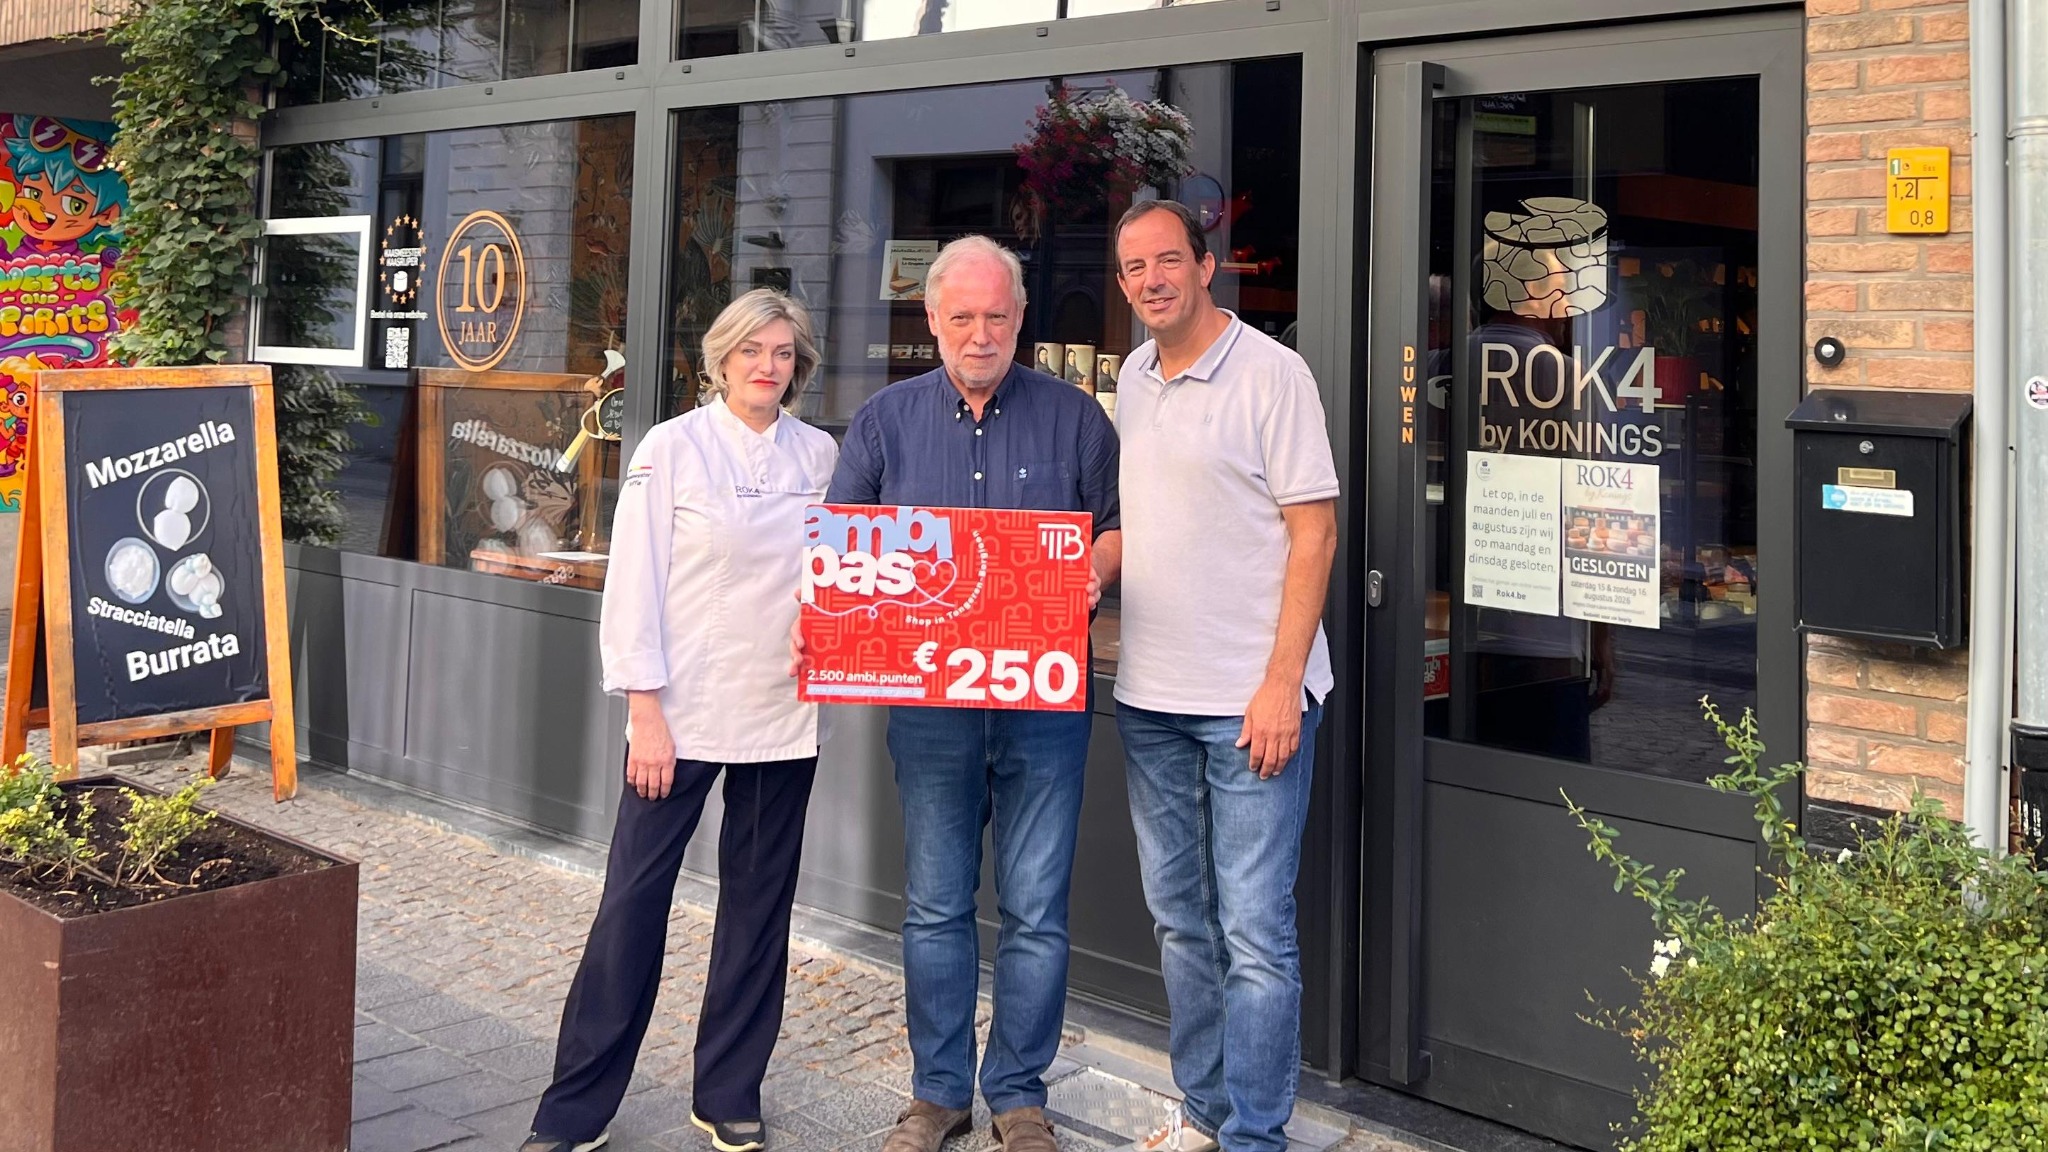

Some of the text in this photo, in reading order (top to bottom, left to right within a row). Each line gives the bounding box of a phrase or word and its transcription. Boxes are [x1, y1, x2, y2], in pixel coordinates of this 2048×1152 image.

[1893, 182, 1914, 200] 1,2
[1910, 210, 1933, 228] 0,8
[455, 244, 506, 313] 10
[458, 321, 497, 345] JAAR
[1481, 342, 1663, 414] ROK4
[1400, 346, 1417, 443] DUWEN
[1480, 416, 1662, 457] by KONINGS
[85, 420, 236, 489] Mozzarella
[1576, 465, 1634, 490] ROK4
[1482, 488, 1544, 503] Let op, in de
[1473, 505, 1553, 520] maanden juli en
[804, 506, 953, 559] ambi
[1472, 521, 1554, 541] augustus zijn wij
[1474, 539, 1551, 556] op maandag en
[801, 544, 917, 603] pas
[1468, 553, 1556, 574] dinsdag gesloten.
[1572, 556, 1647, 579] GESLOTEN
[1496, 589, 1527, 600] Rok4.be
[1571, 581, 1596, 591] zaterdag
[1598, 583, 1605, 591] 15
[1613, 585, 1637, 596] zondag
[1584, 593, 1613, 603] augustus
[87, 596, 195, 640] Stracciatella
[905, 614, 932, 627] Shop
[934, 616, 945, 625] in
[126, 631, 240, 682] Burrata
[807, 669, 923, 684] 2.500 ambi.punten
[913, 640, 1079, 704] € 250
